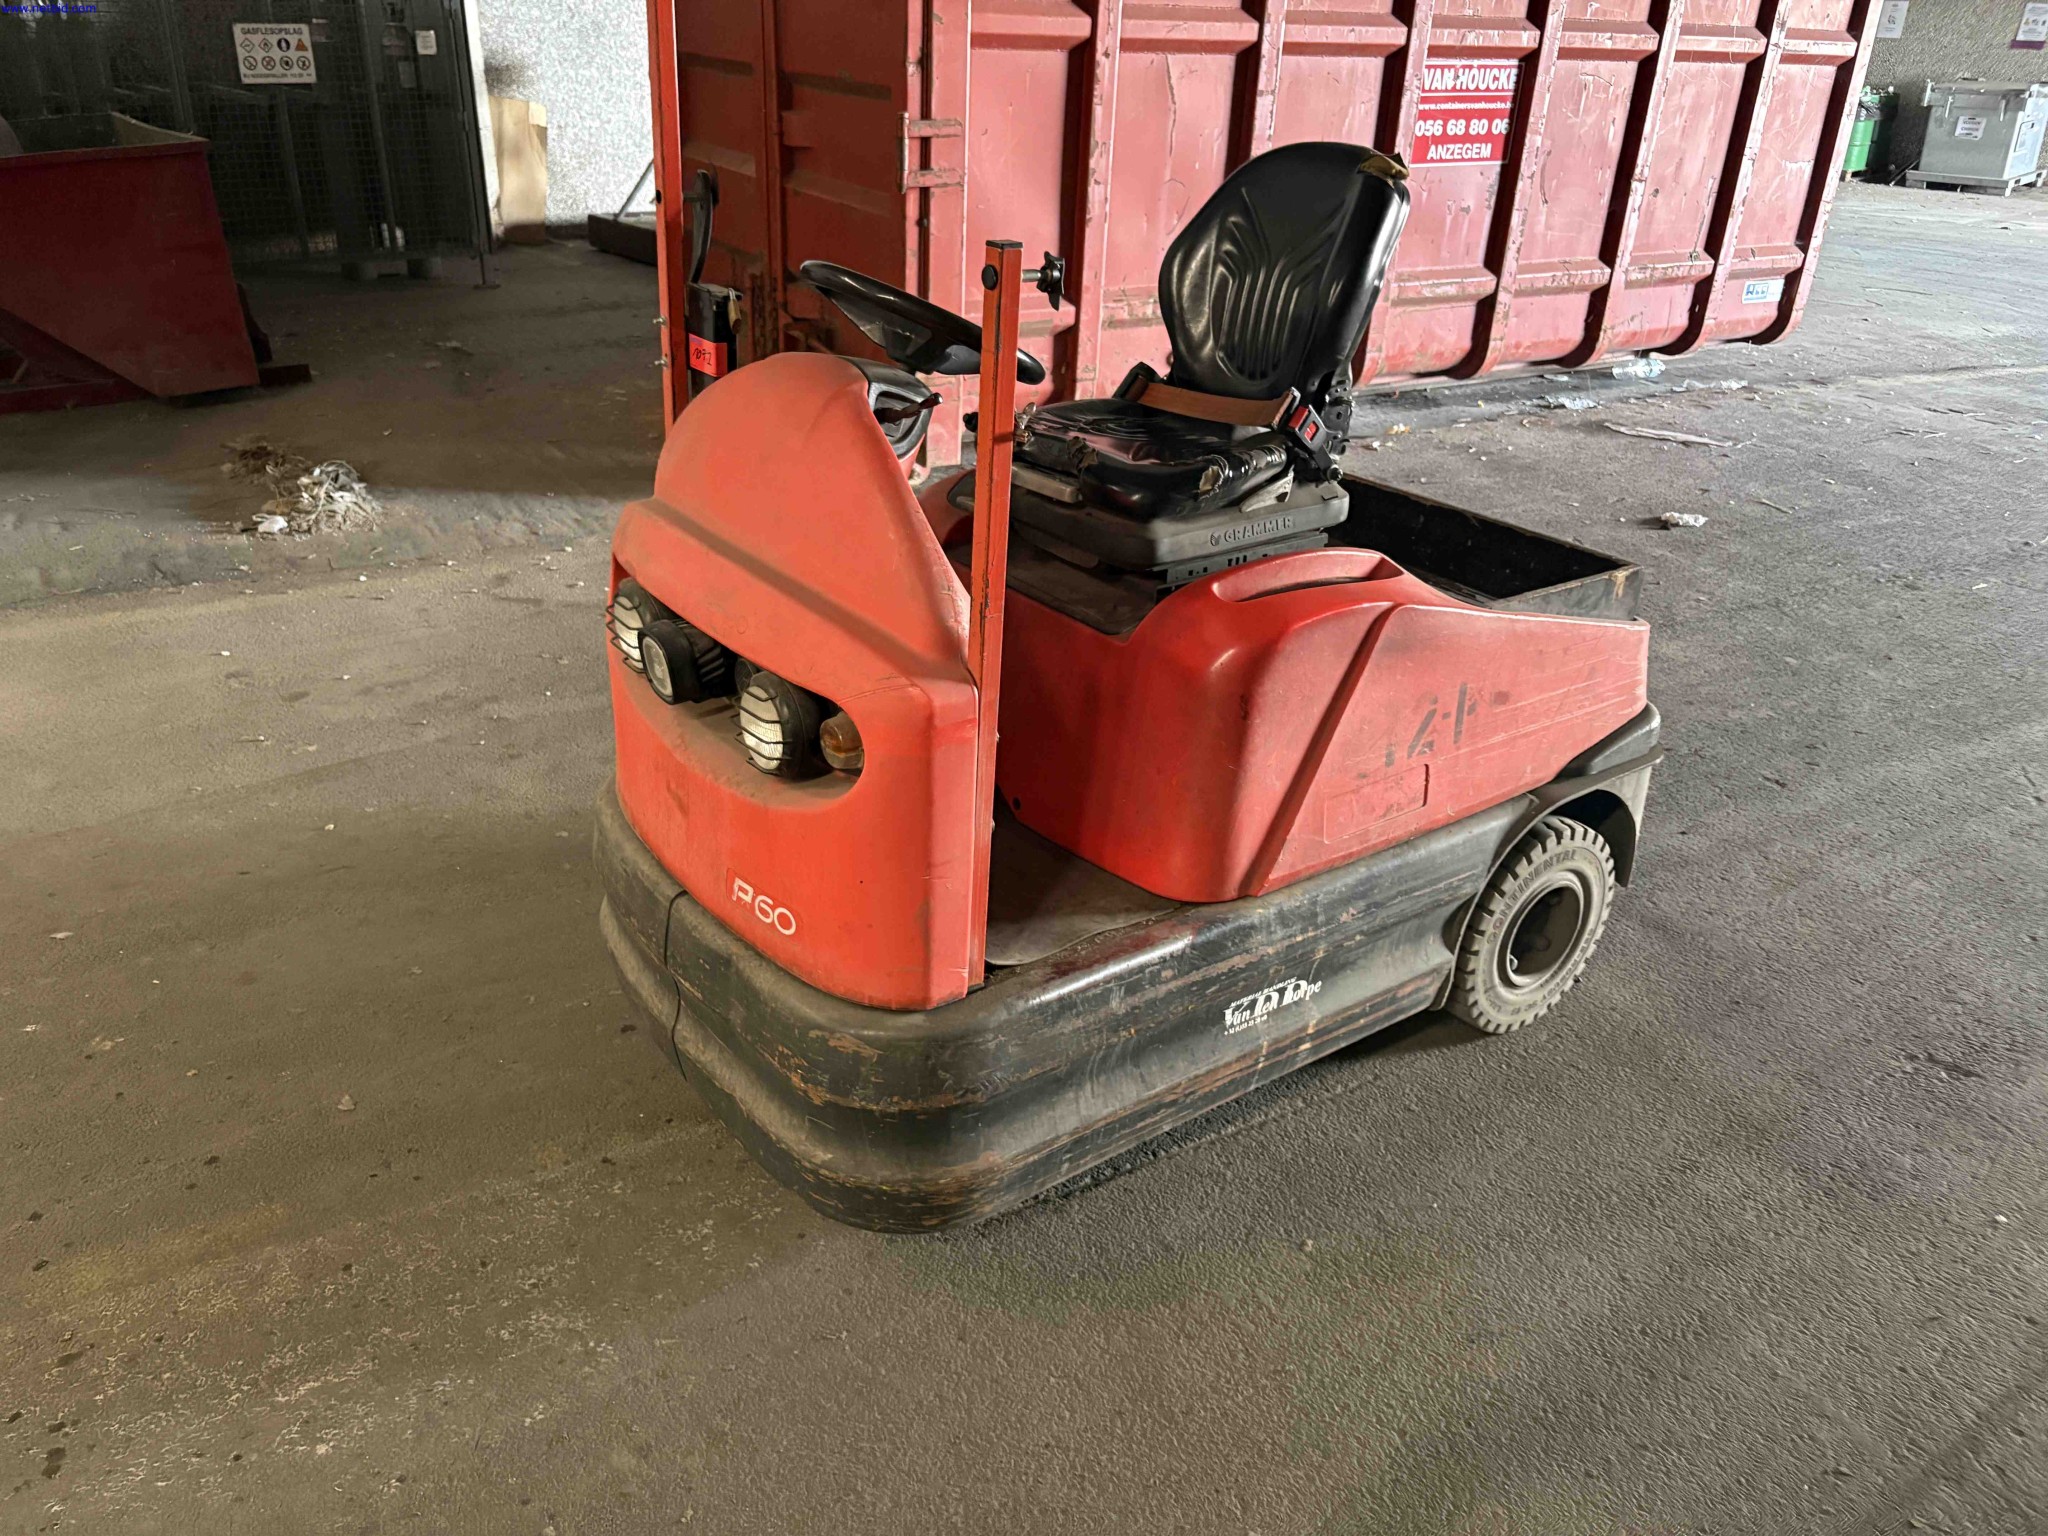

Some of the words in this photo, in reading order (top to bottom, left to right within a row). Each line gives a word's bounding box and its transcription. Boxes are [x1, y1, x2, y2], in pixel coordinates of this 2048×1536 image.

[1423, 67, 1456, 91] VAN
[1455, 67, 1519, 91] HOUCKE
[1414, 119, 1444, 137] 056
[1446, 118, 1466, 136] 68
[1468, 118, 1489, 136] 80
[1491, 118, 1510, 136] 06
[1426, 142, 1493, 161] ANZEGEM
[1223, 517, 1297, 543] GRAMMER
[1486, 849, 1577, 946] CONTINENTAL
[1223, 1000, 1251, 1030] Van
